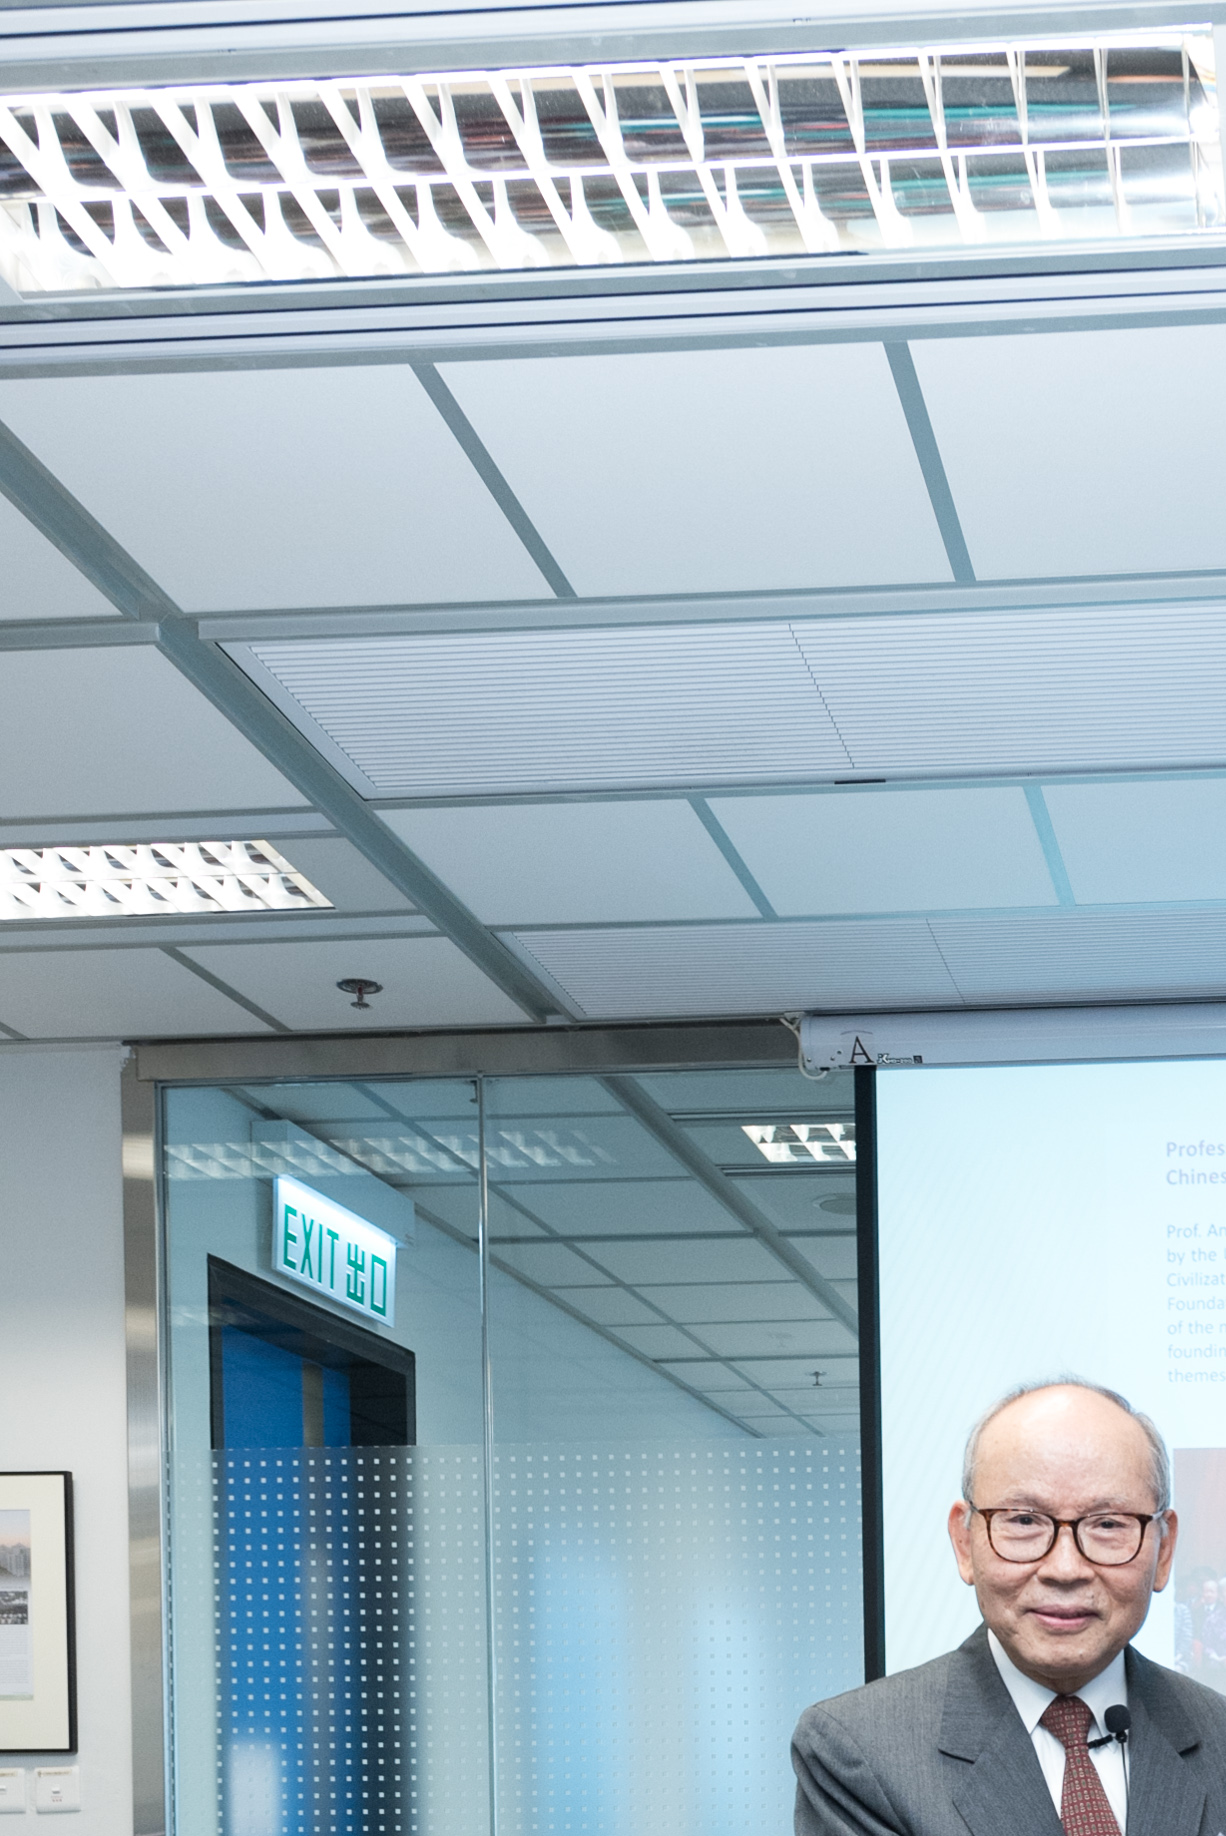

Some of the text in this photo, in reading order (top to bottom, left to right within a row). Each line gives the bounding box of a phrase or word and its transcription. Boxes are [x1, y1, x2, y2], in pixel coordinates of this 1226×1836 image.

[848, 1035, 875, 1064] A
[1166, 1222, 1202, 1239] Prof.
[283, 1203, 387, 1317] EXIT 出口
[1166, 1247, 1186, 1266] by
[1190, 1247, 1218, 1263] the
[1166, 1319, 1184, 1336] of
[1187, 1319, 1215, 1335] the
[1167, 1367, 1226, 1383] themes
